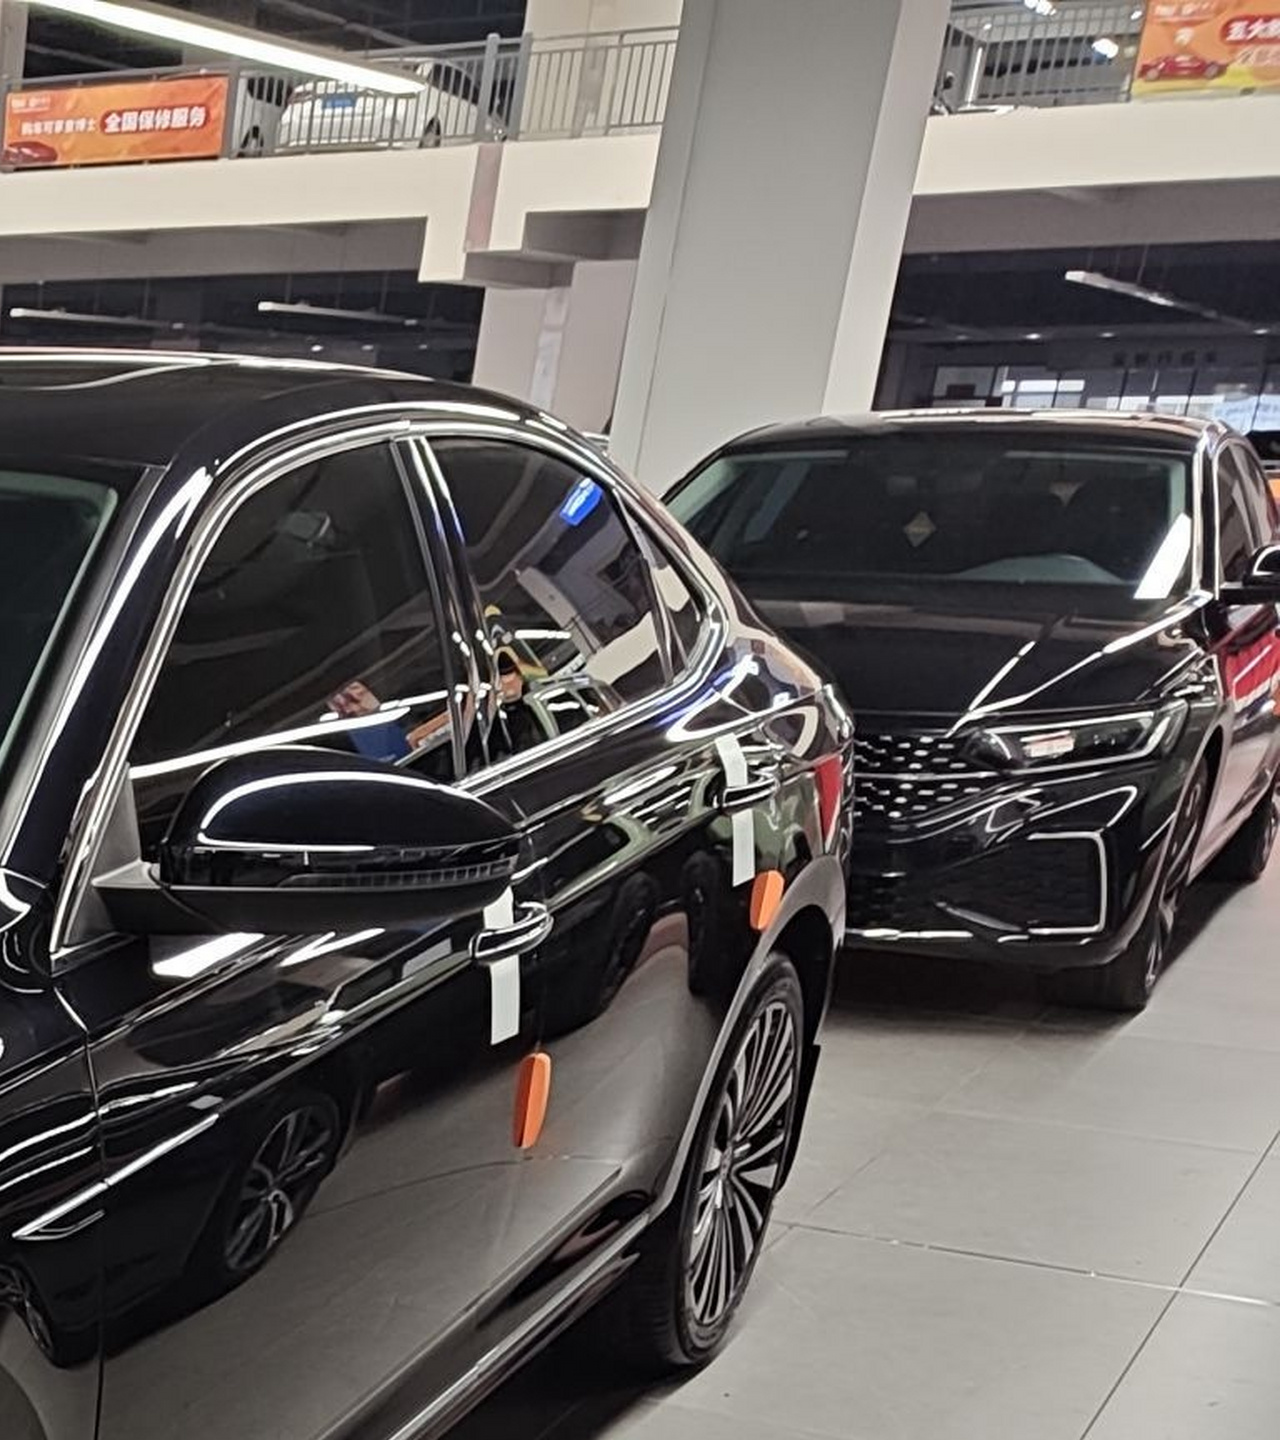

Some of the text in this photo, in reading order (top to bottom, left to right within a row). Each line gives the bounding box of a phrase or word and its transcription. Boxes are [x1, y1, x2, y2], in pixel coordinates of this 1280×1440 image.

[104, 106, 206, 134] 全国保修服务
